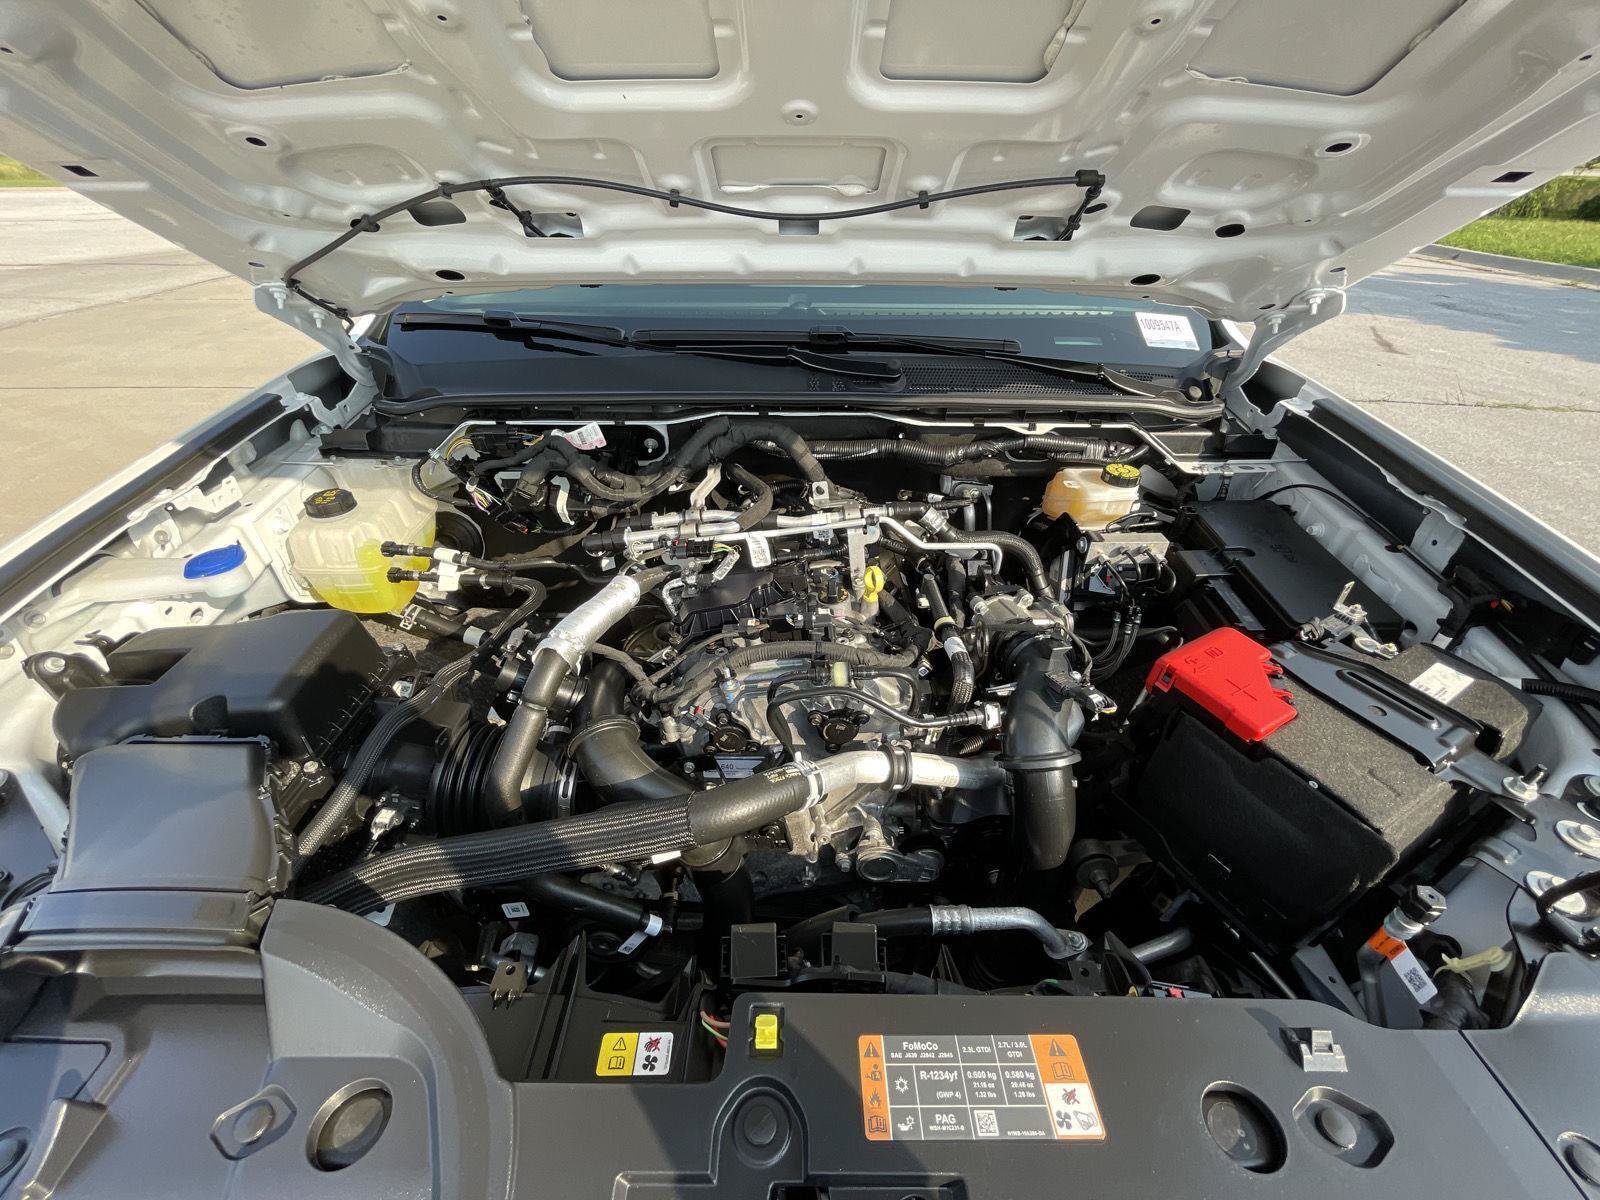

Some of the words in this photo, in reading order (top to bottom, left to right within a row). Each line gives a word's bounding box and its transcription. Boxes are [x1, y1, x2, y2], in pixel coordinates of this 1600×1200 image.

[902, 1041, 938, 1051] FoMoCo
[997, 1041, 1010, 1049] 2.7L
[919, 1070, 958, 1082] R-1234yf
[966, 1070, 987, 1079] 0.600
[987, 1070, 997, 1080] kg
[1025, 1070, 1036, 1080] kg
[936, 1091, 954, 1100] (GWP
[954, 1091, 962, 1100] 4)
[935, 1113, 957, 1125] PAG
